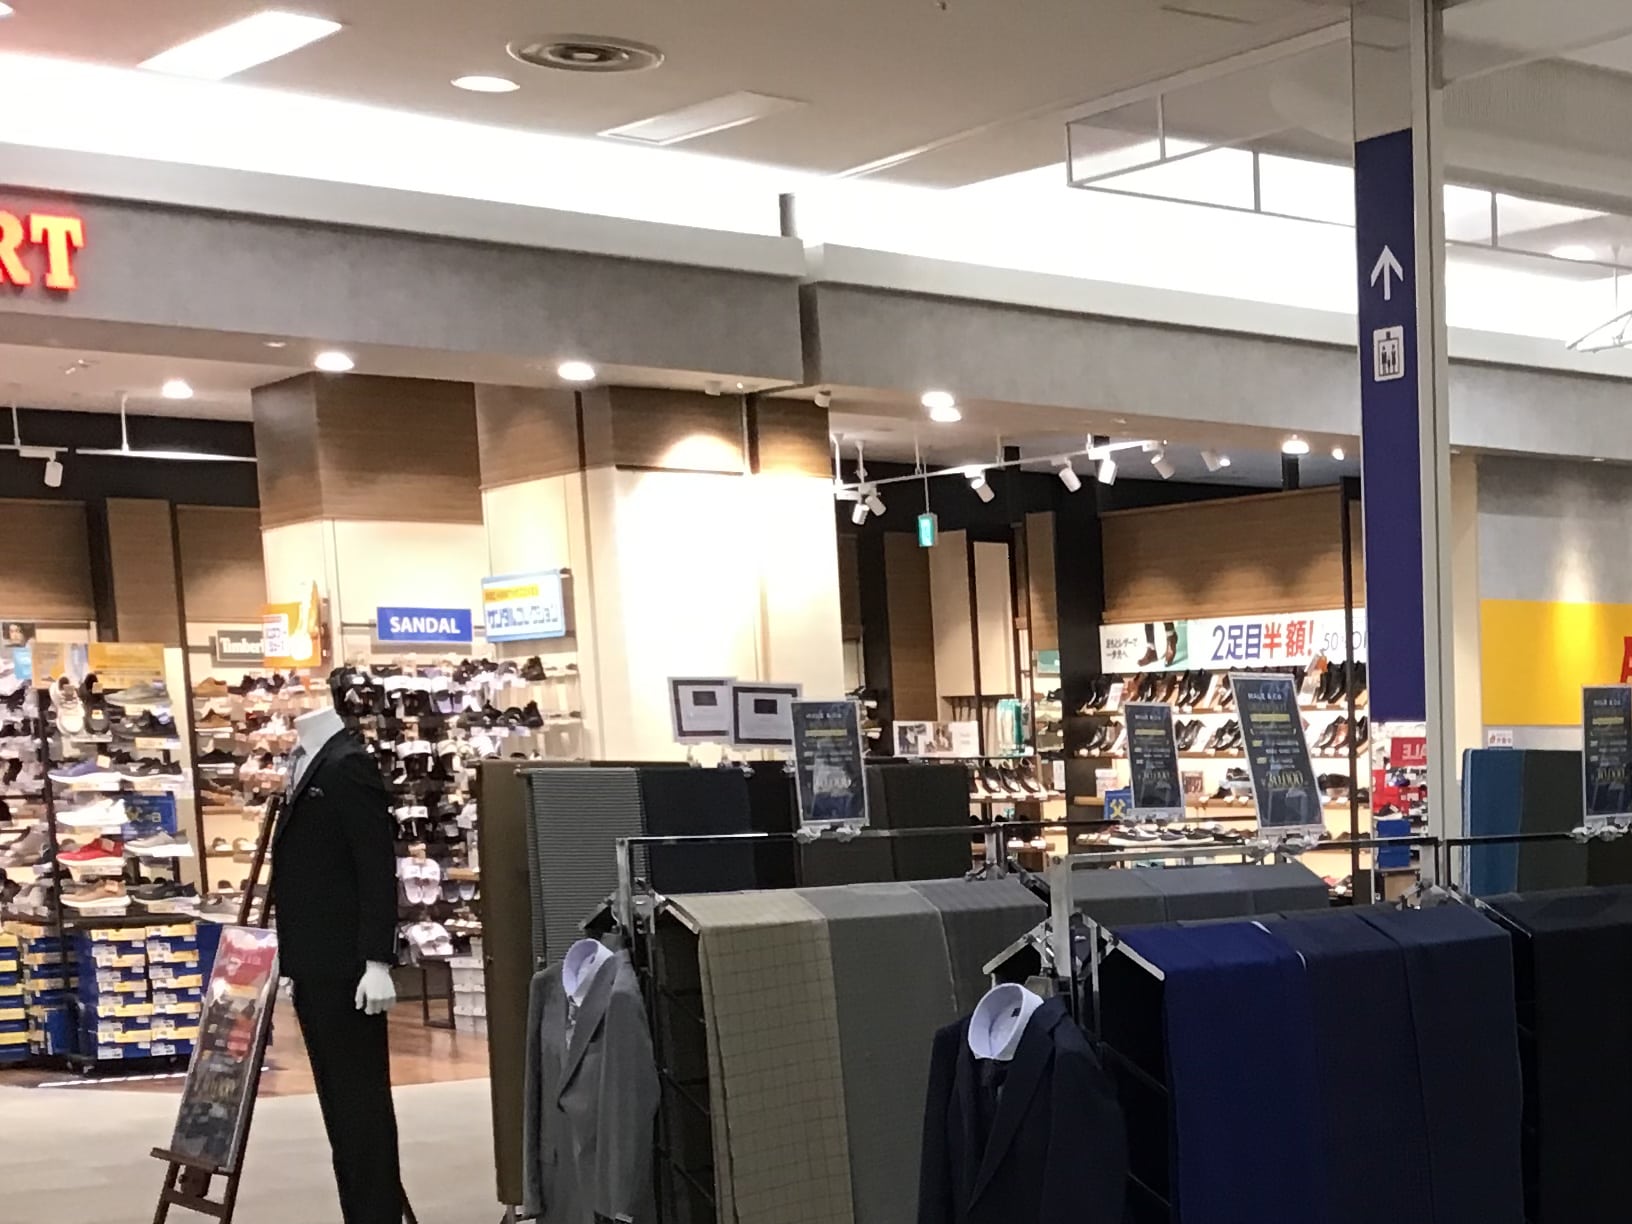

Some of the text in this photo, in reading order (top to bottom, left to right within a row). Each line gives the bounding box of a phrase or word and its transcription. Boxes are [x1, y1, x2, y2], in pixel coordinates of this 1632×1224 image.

[389, 615, 461, 634] SANDAL
[1211, 619, 1315, 661] 2足目半額!
